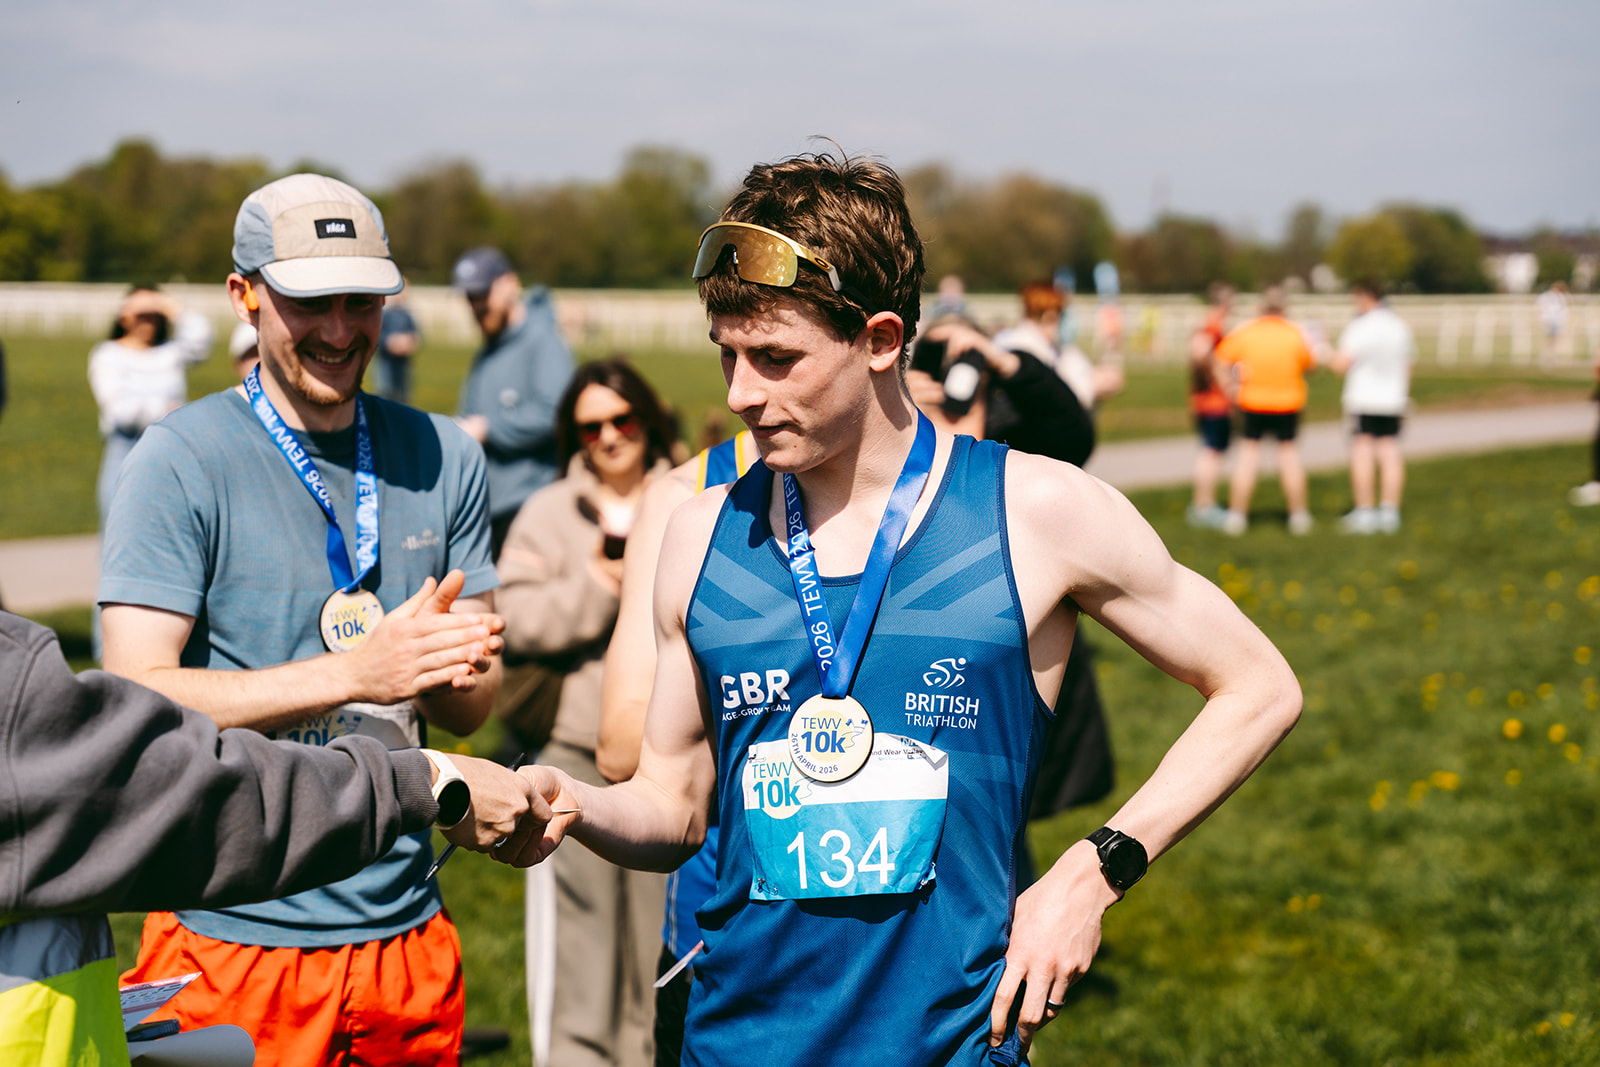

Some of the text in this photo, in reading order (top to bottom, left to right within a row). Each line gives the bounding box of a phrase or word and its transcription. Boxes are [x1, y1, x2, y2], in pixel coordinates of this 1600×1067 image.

[271, 427, 309, 472] TEWV
[789, 511, 809, 555] 2026
[330, 608, 358, 622] TEWV
[332, 619, 365, 640] 10k
[720, 669, 791, 709] GBR
[905, 692, 979, 716] BRITISH
[801, 717, 841, 729] TEWV
[905, 713, 976, 729] TRIATHLON
[791, 733, 838, 774] 26TH APRIL 2026
[801, 730, 846, 753] 10k
[752, 762, 793, 779] TEWV
[753, 777, 801, 808] 10k
[787, 827, 896, 889] 134
